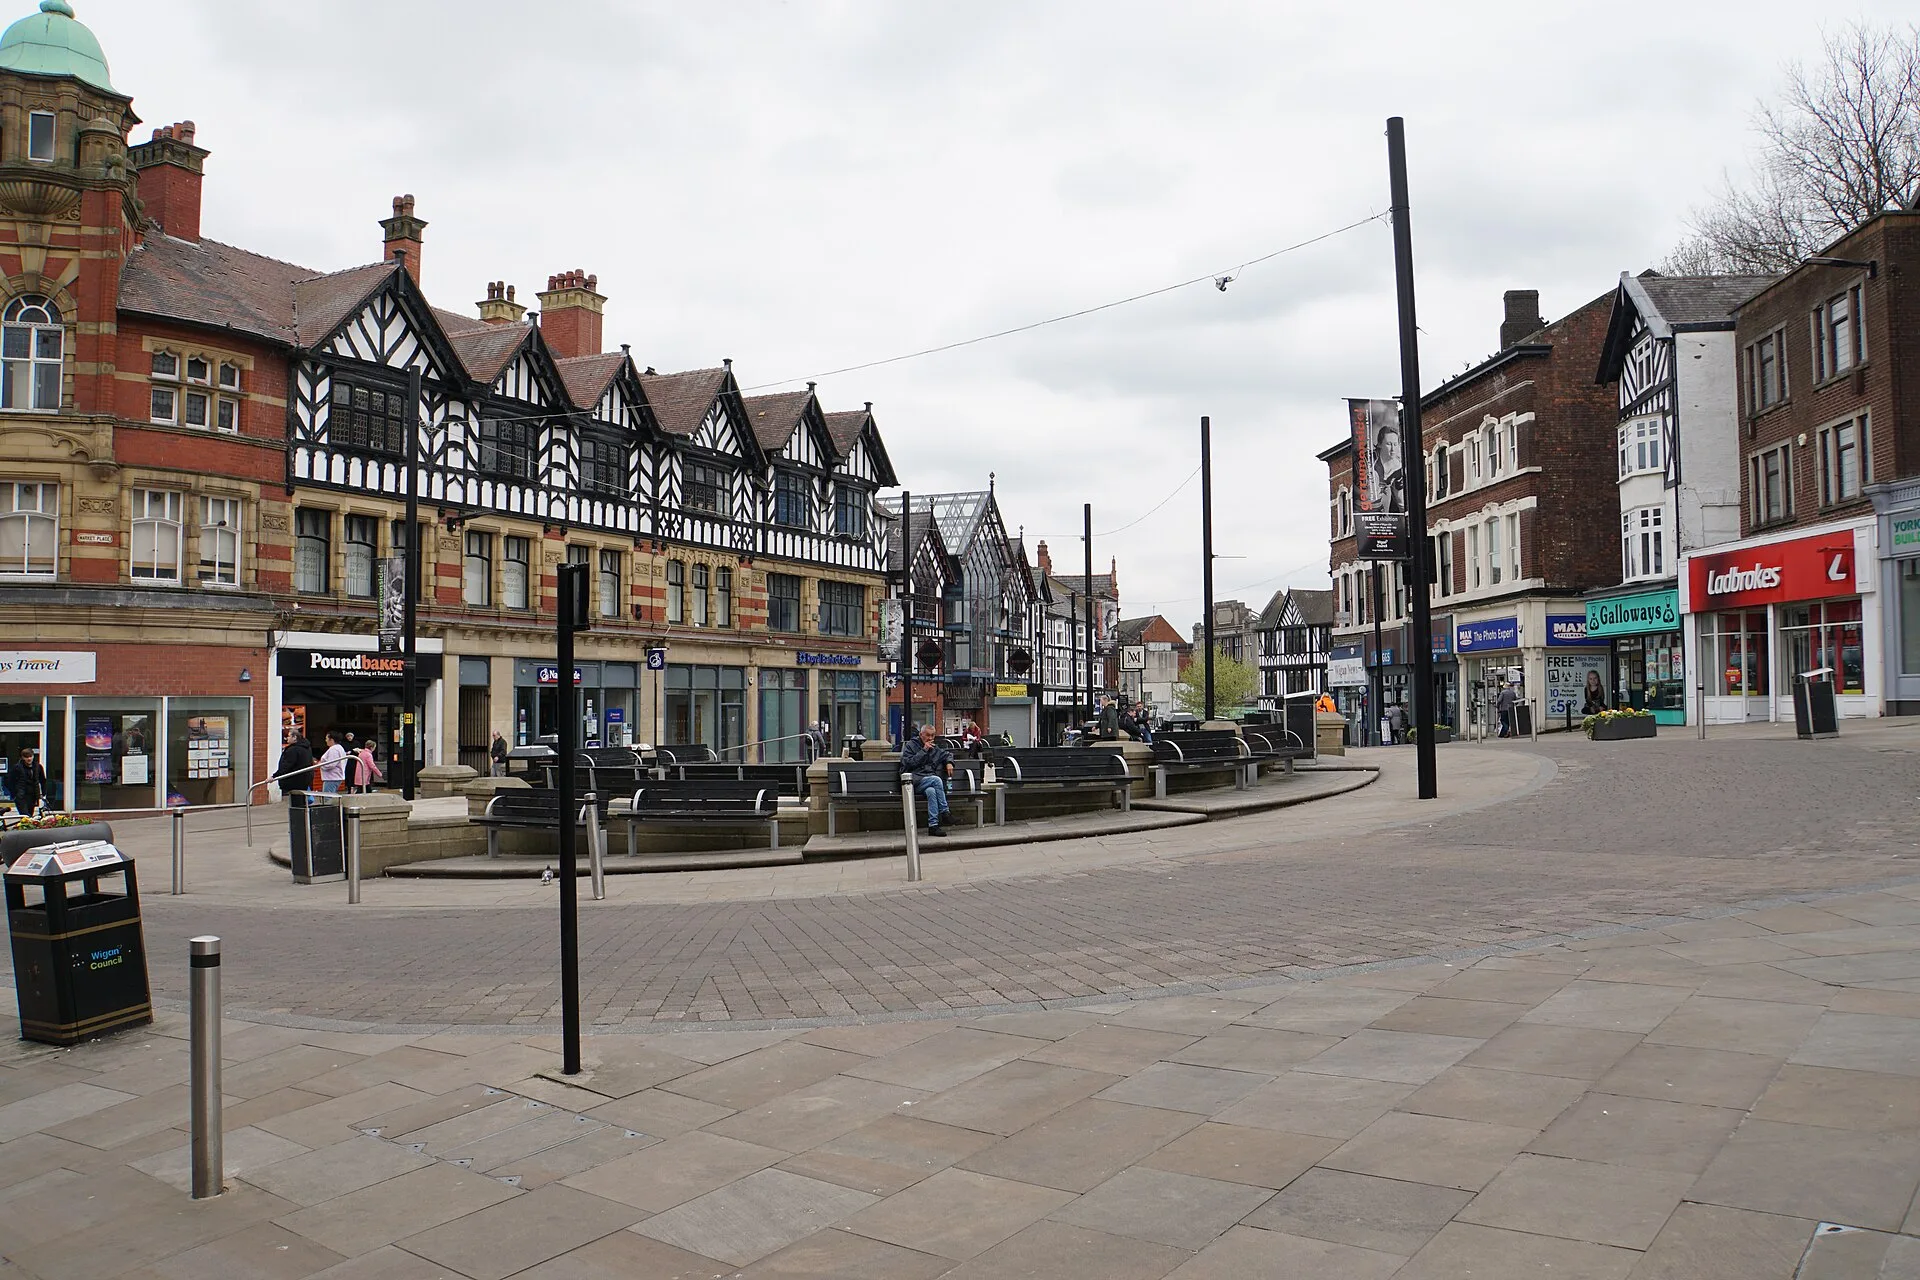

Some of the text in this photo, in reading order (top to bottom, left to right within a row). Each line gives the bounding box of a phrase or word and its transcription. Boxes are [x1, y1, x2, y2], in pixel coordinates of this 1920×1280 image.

[1707, 563, 1783, 596] Ladbrokes
[1600, 604, 1662, 625] Galloways
[1553, 622, 1587, 633] MAX
[1460, 628, 1514, 641] MAX The Photo Expert
[17, 659, 60, 670] Travel
[310, 652, 404, 671] Poundbaker
[1547, 656, 1575, 667] FREE
[1550, 688, 1559, 697] 10
[91, 948, 121, 960] Wigan
[90, 955, 123, 970] Council
